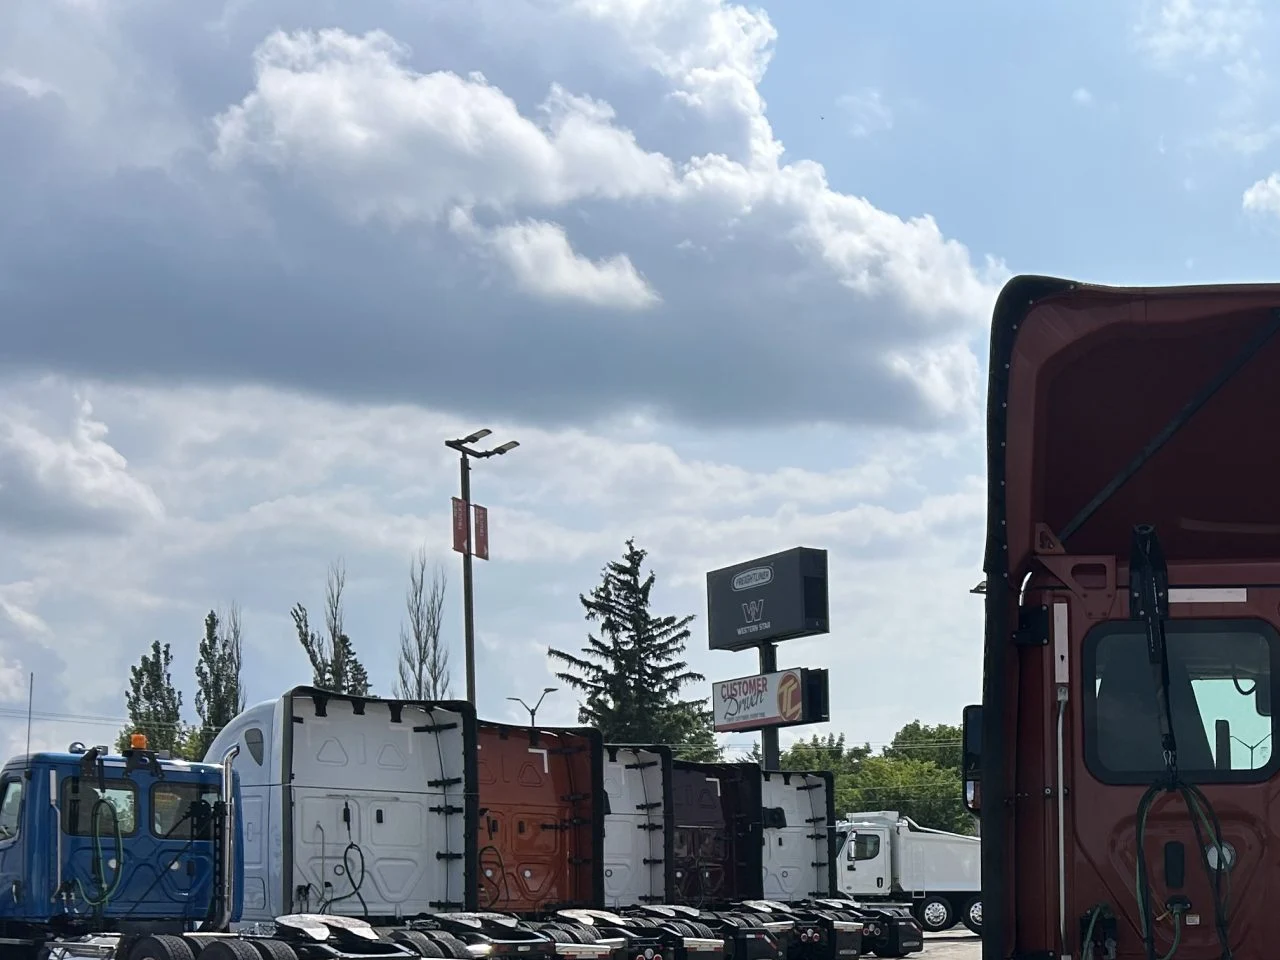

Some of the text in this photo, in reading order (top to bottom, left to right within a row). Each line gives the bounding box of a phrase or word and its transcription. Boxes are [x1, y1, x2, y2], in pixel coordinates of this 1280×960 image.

[737, 621, 771, 635] WESTERN STAR
[720, 677, 768, 699] CUSTOMER
[724, 691, 764, 719] Driven
